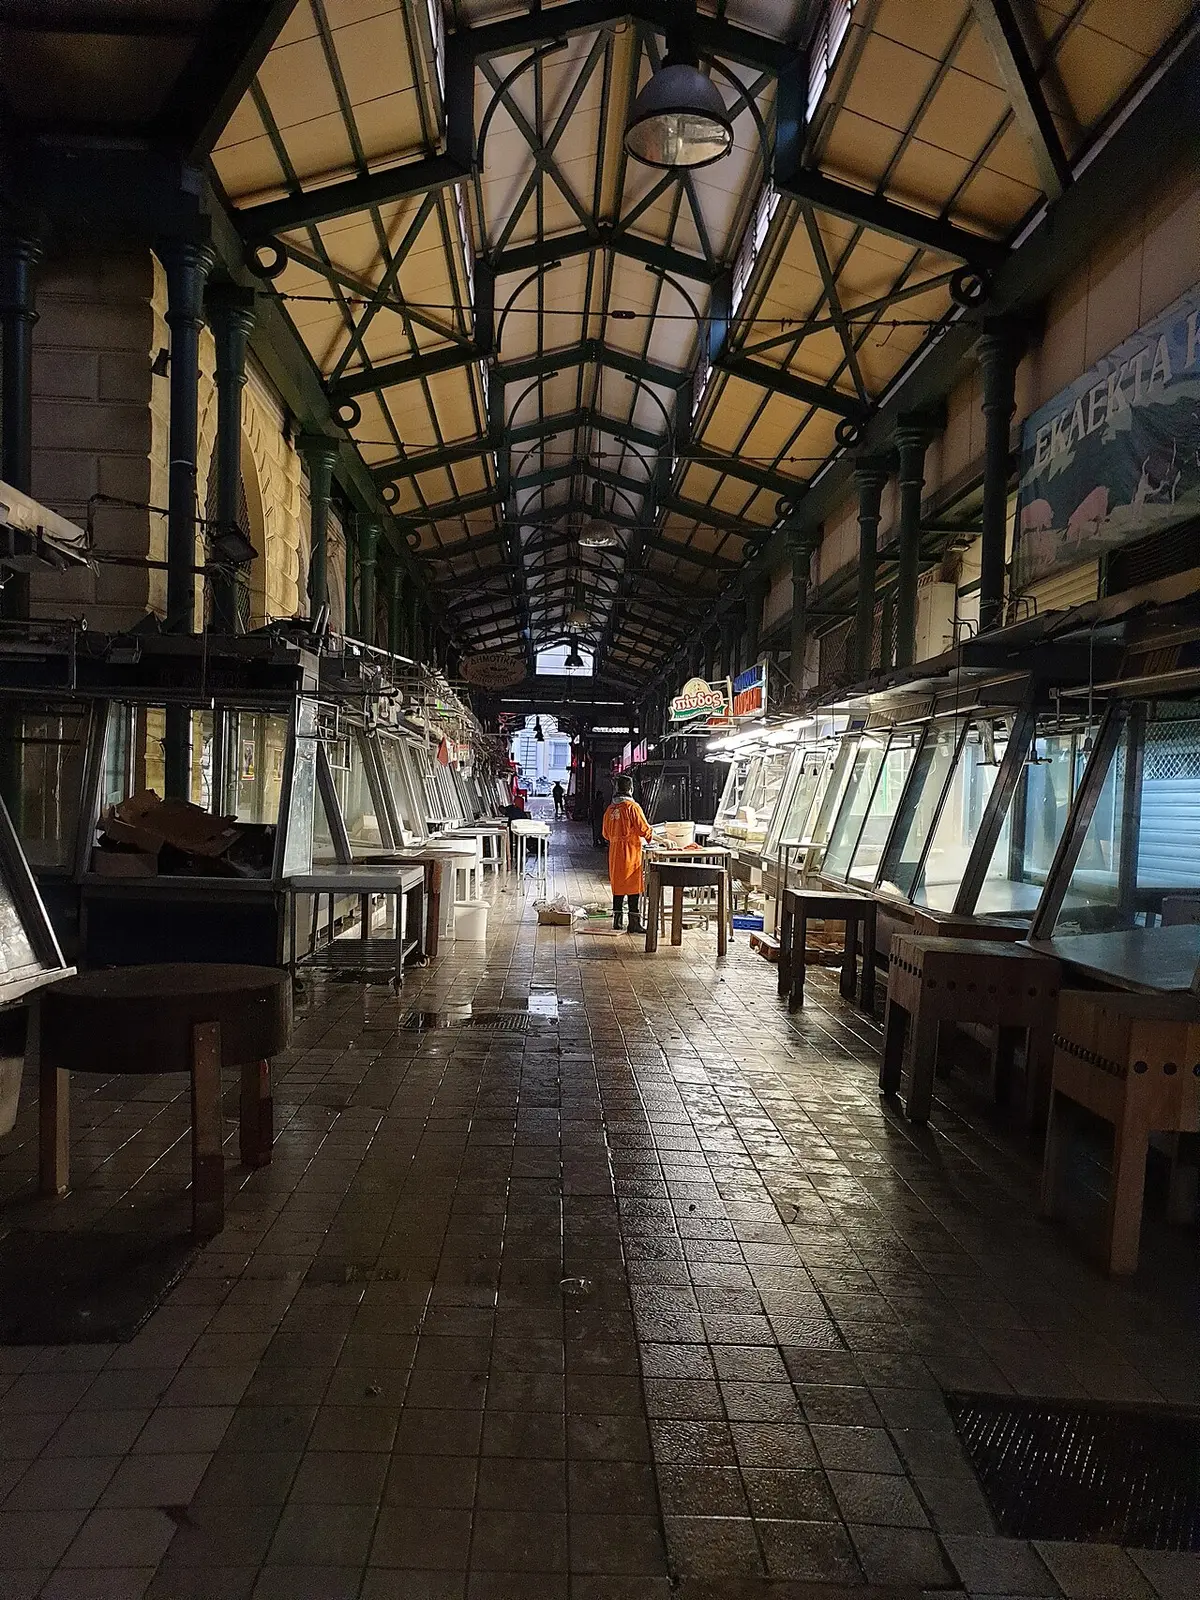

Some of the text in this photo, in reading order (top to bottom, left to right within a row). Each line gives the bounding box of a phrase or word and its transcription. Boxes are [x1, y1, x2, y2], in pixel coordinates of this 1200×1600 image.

[1034, 334, 1173, 469] ΕΚΛΕΚΤΑ
[470, 654, 517, 667] ΔΗΜΟΤΙΚΗ
[675, 691, 722, 711] πίνδος
